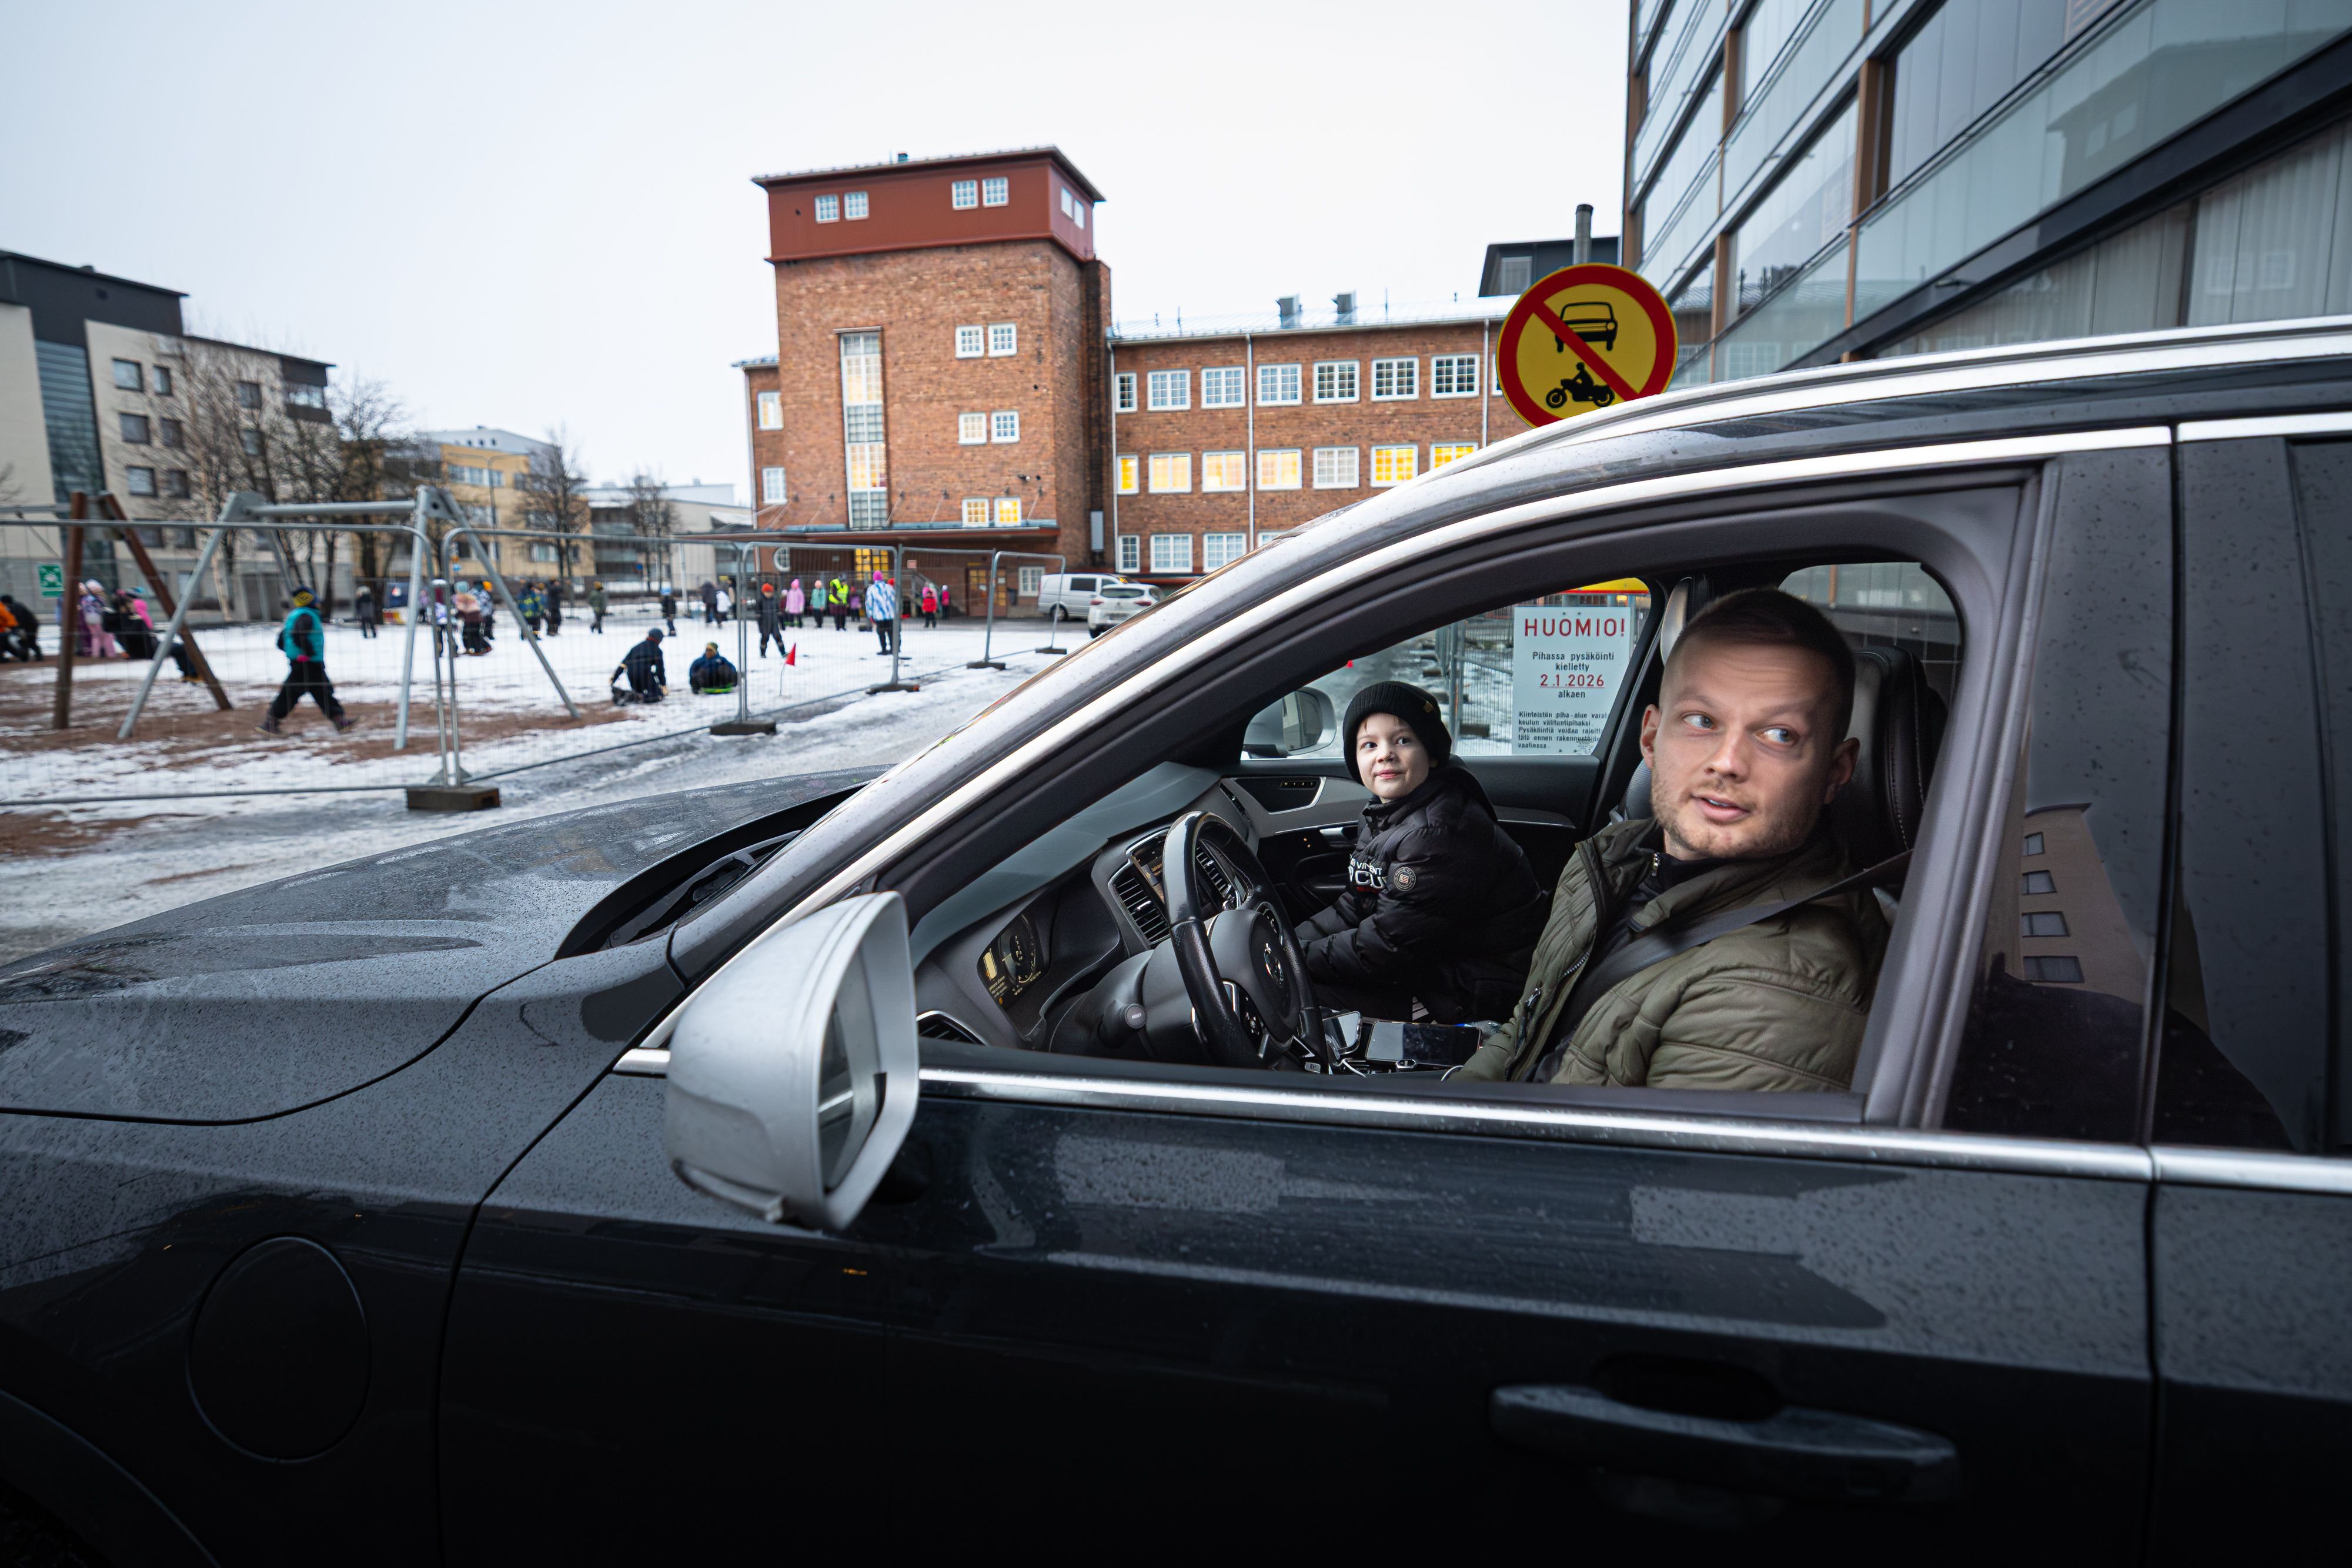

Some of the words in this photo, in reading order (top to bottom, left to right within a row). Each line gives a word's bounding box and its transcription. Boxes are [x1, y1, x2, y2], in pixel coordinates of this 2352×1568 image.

[1525, 618, 1625, 637] HUOMIO!
[1532, 651, 1565, 660] Pihassa
[1571, 651, 1615, 662] pysäköinti
[1556, 663, 1590, 672] kielletty
[1558, 690, 1586, 698] alkaen
